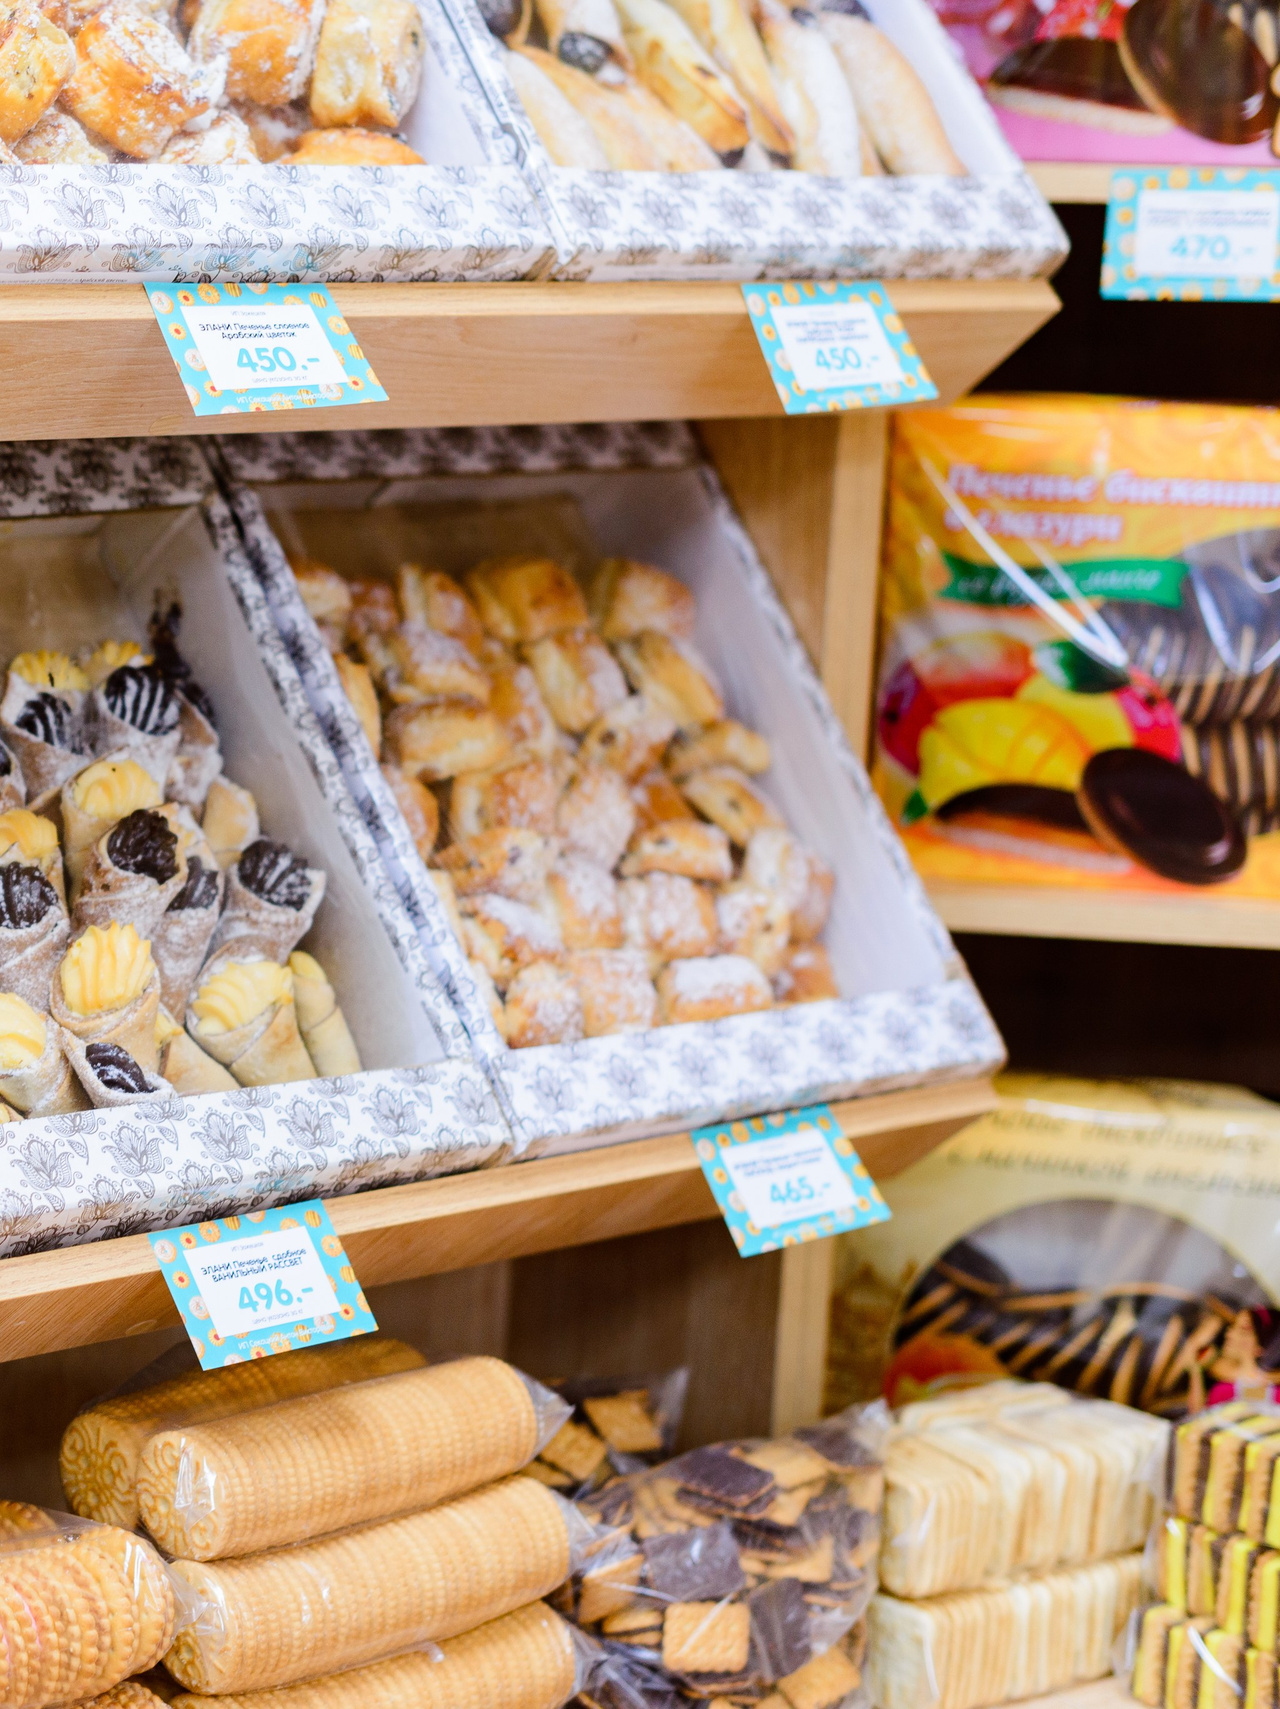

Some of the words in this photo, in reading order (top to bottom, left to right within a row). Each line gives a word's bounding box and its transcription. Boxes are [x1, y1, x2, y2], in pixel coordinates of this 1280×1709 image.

[199, 323, 232, 332] ЭЛАНИ
[233, 323, 271, 331] Печенье
[221, 330, 264, 341] Арабский
[265, 331, 297, 340] цветок
[236, 346, 320, 373] 450.-
[947, 462, 1097, 500] Печенье
[201, 1262, 231, 1275] ЭЛАНИ
[233, 1256, 268, 1270] Печенье
[272, 1248, 307, 1261] сдобное
[212, 1265, 268, 1283] ВАНИЛЬНЫЙ
[268, 1256, 303, 1272] РАССВЕТ
[238, 1278, 314, 1313] 496.-
